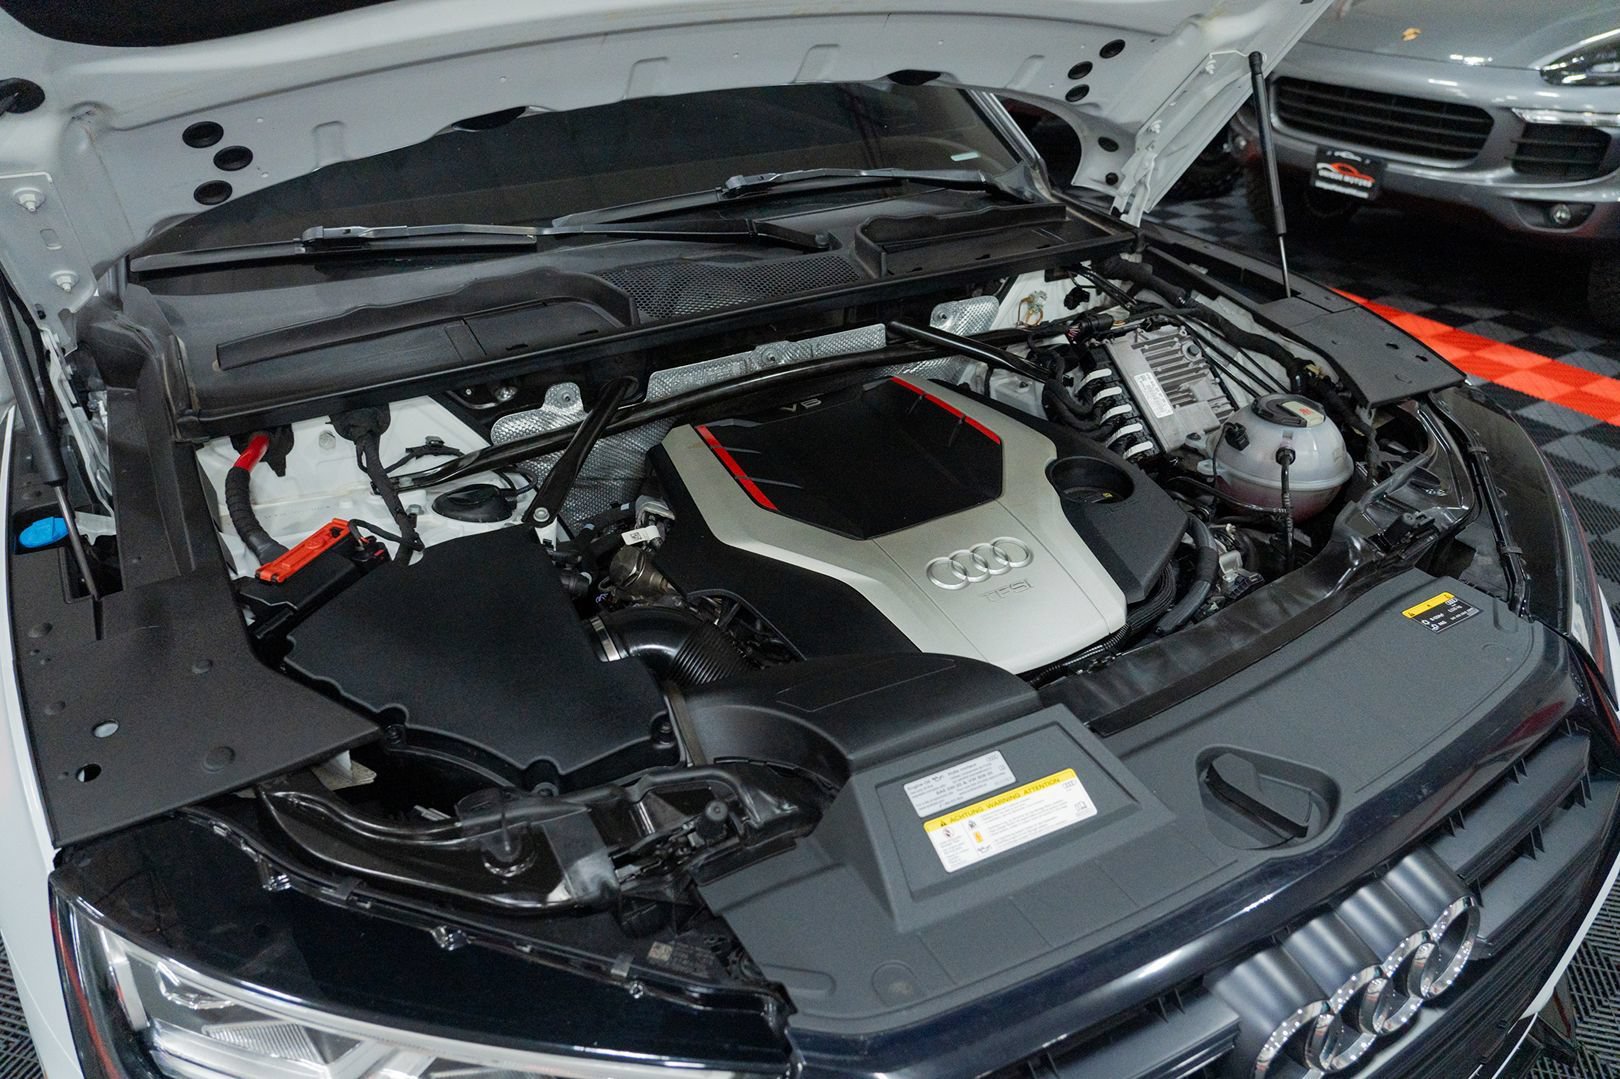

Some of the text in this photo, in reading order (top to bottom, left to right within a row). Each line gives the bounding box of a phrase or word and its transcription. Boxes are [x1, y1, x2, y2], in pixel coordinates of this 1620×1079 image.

[982, 579, 1034, 602] TFSI
[950, 807, 984, 823] ACHTUNG
[987, 793, 1021, 809] WARNING
[1023, 778, 1061, 795] ATTENTION
